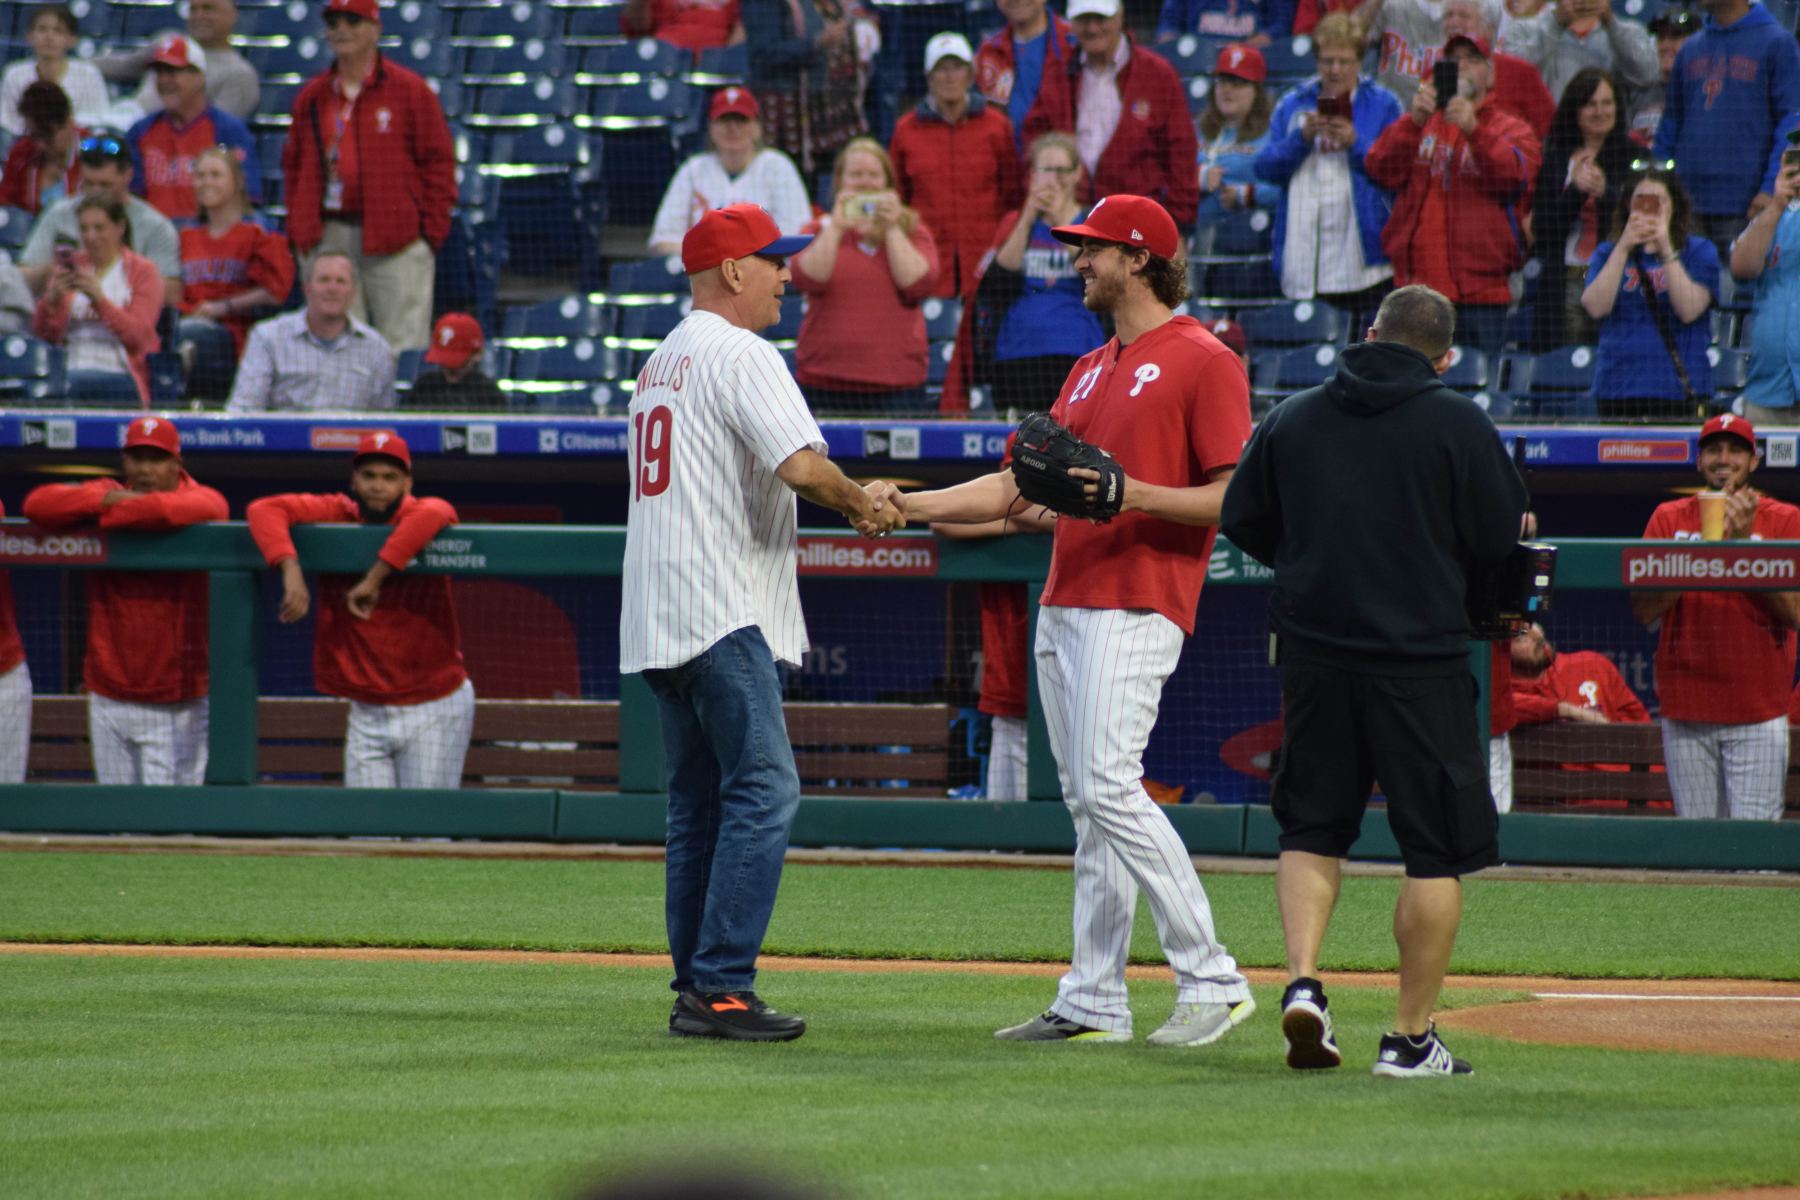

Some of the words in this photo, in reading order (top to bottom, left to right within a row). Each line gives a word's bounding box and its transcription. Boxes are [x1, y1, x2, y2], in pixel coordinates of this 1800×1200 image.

[1068, 365, 1103, 405] 27
[1129, 363, 1161, 397] P
[235, 430, 265, 447] Park
[634, 405, 673, 503] 19
[0, 536, 101, 556] ies.com
[796, 543, 931, 567] hillies.com
[425, 555, 487, 568] TRANSFER
[1629, 553, 1794, 582] phillies.com
